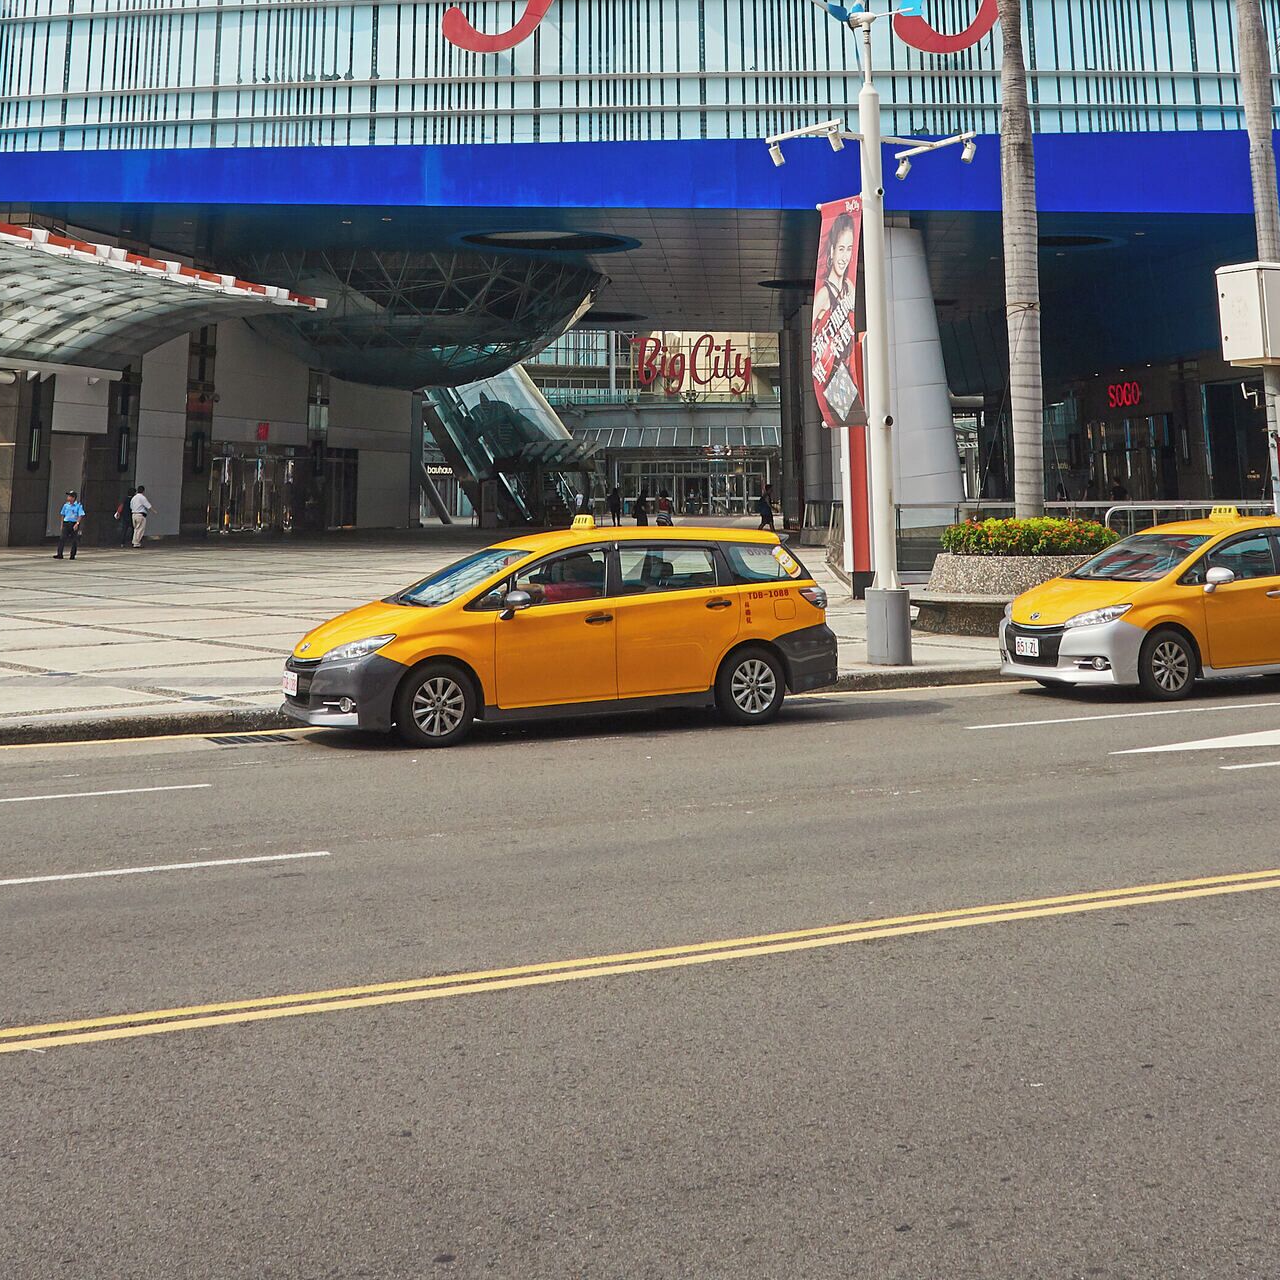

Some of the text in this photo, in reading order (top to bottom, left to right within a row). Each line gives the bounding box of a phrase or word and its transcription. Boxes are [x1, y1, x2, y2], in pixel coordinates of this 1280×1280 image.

[629, 334, 751, 395] Big City
[1108, 382, 1140, 408] SOGO
[427, 465, 453, 474] bauhaus
